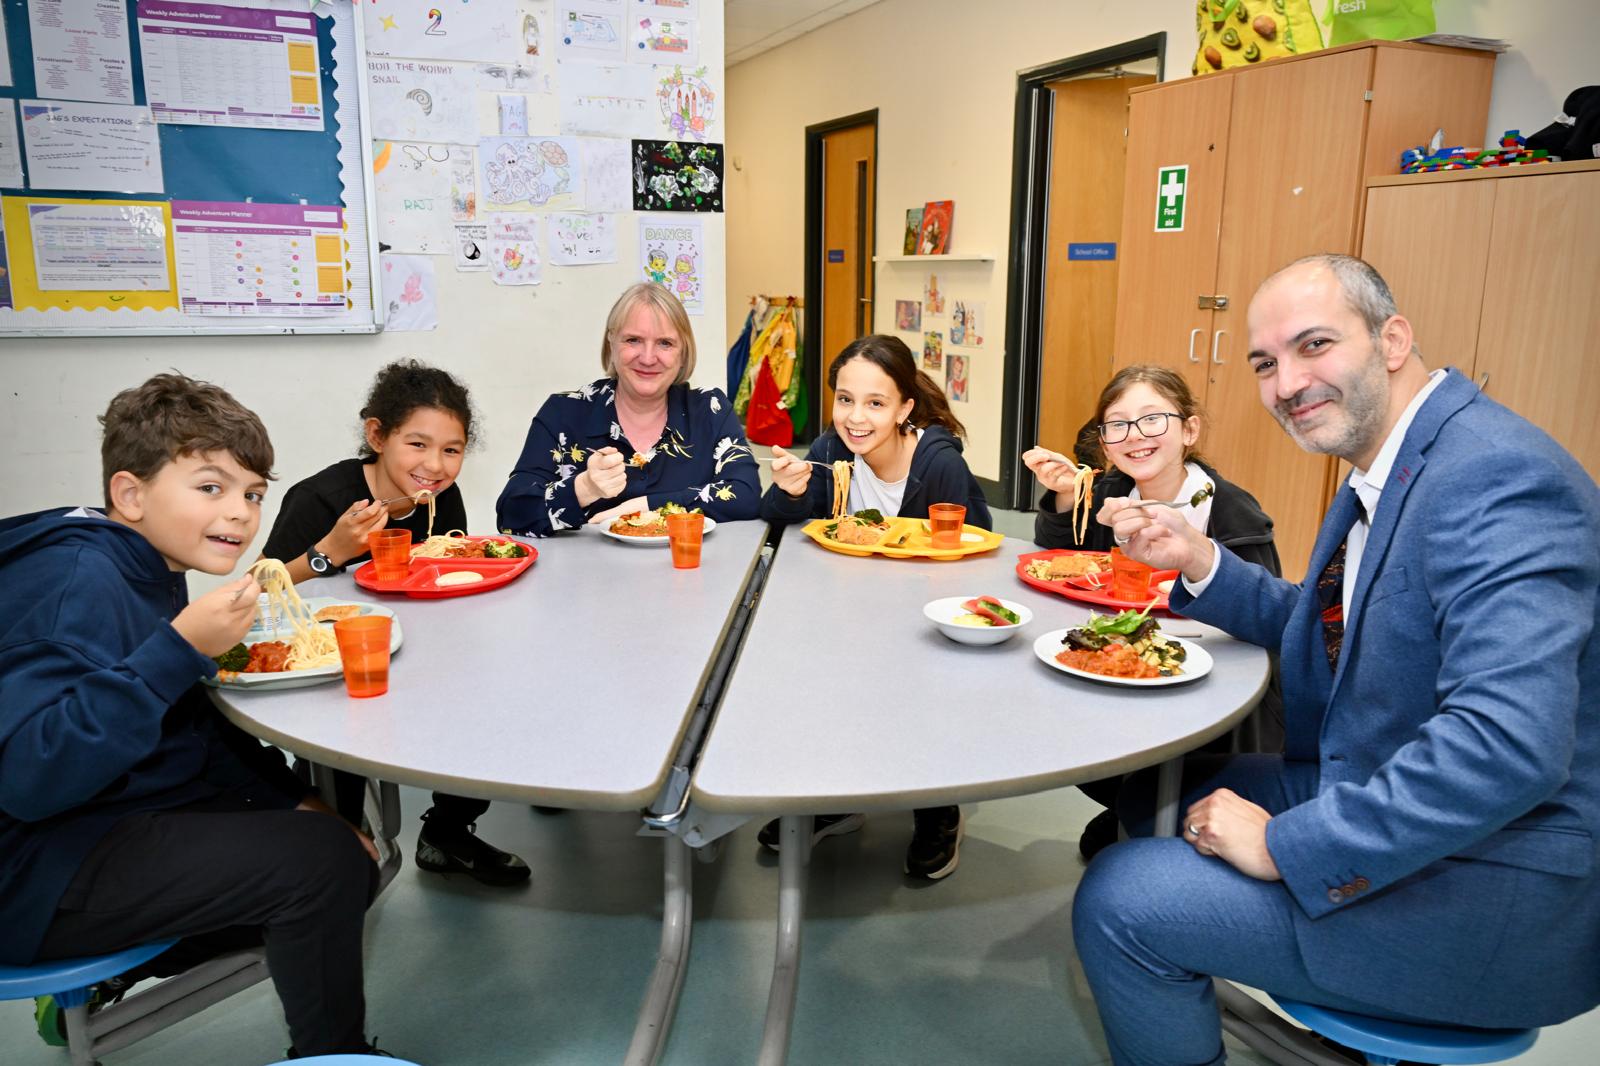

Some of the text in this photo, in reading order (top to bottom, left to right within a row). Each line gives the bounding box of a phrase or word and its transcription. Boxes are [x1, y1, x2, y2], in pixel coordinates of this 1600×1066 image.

[145, 9, 168, 17] Weekly
[168, 10, 199, 18] Adventure
[425, 9, 447, 35] 2
[395, 62, 414, 71] THE
[372, 75, 401, 84] SNAIL
[72, 115, 134, 126] EXPECTATIONS
[179, 209, 201, 217] Weekly
[1163, 207, 1177, 216] First
[1165, 218, 1174, 226] aid
[645, 228, 693, 242] DANCE
[1075, 248, 1109, 256] School Office
